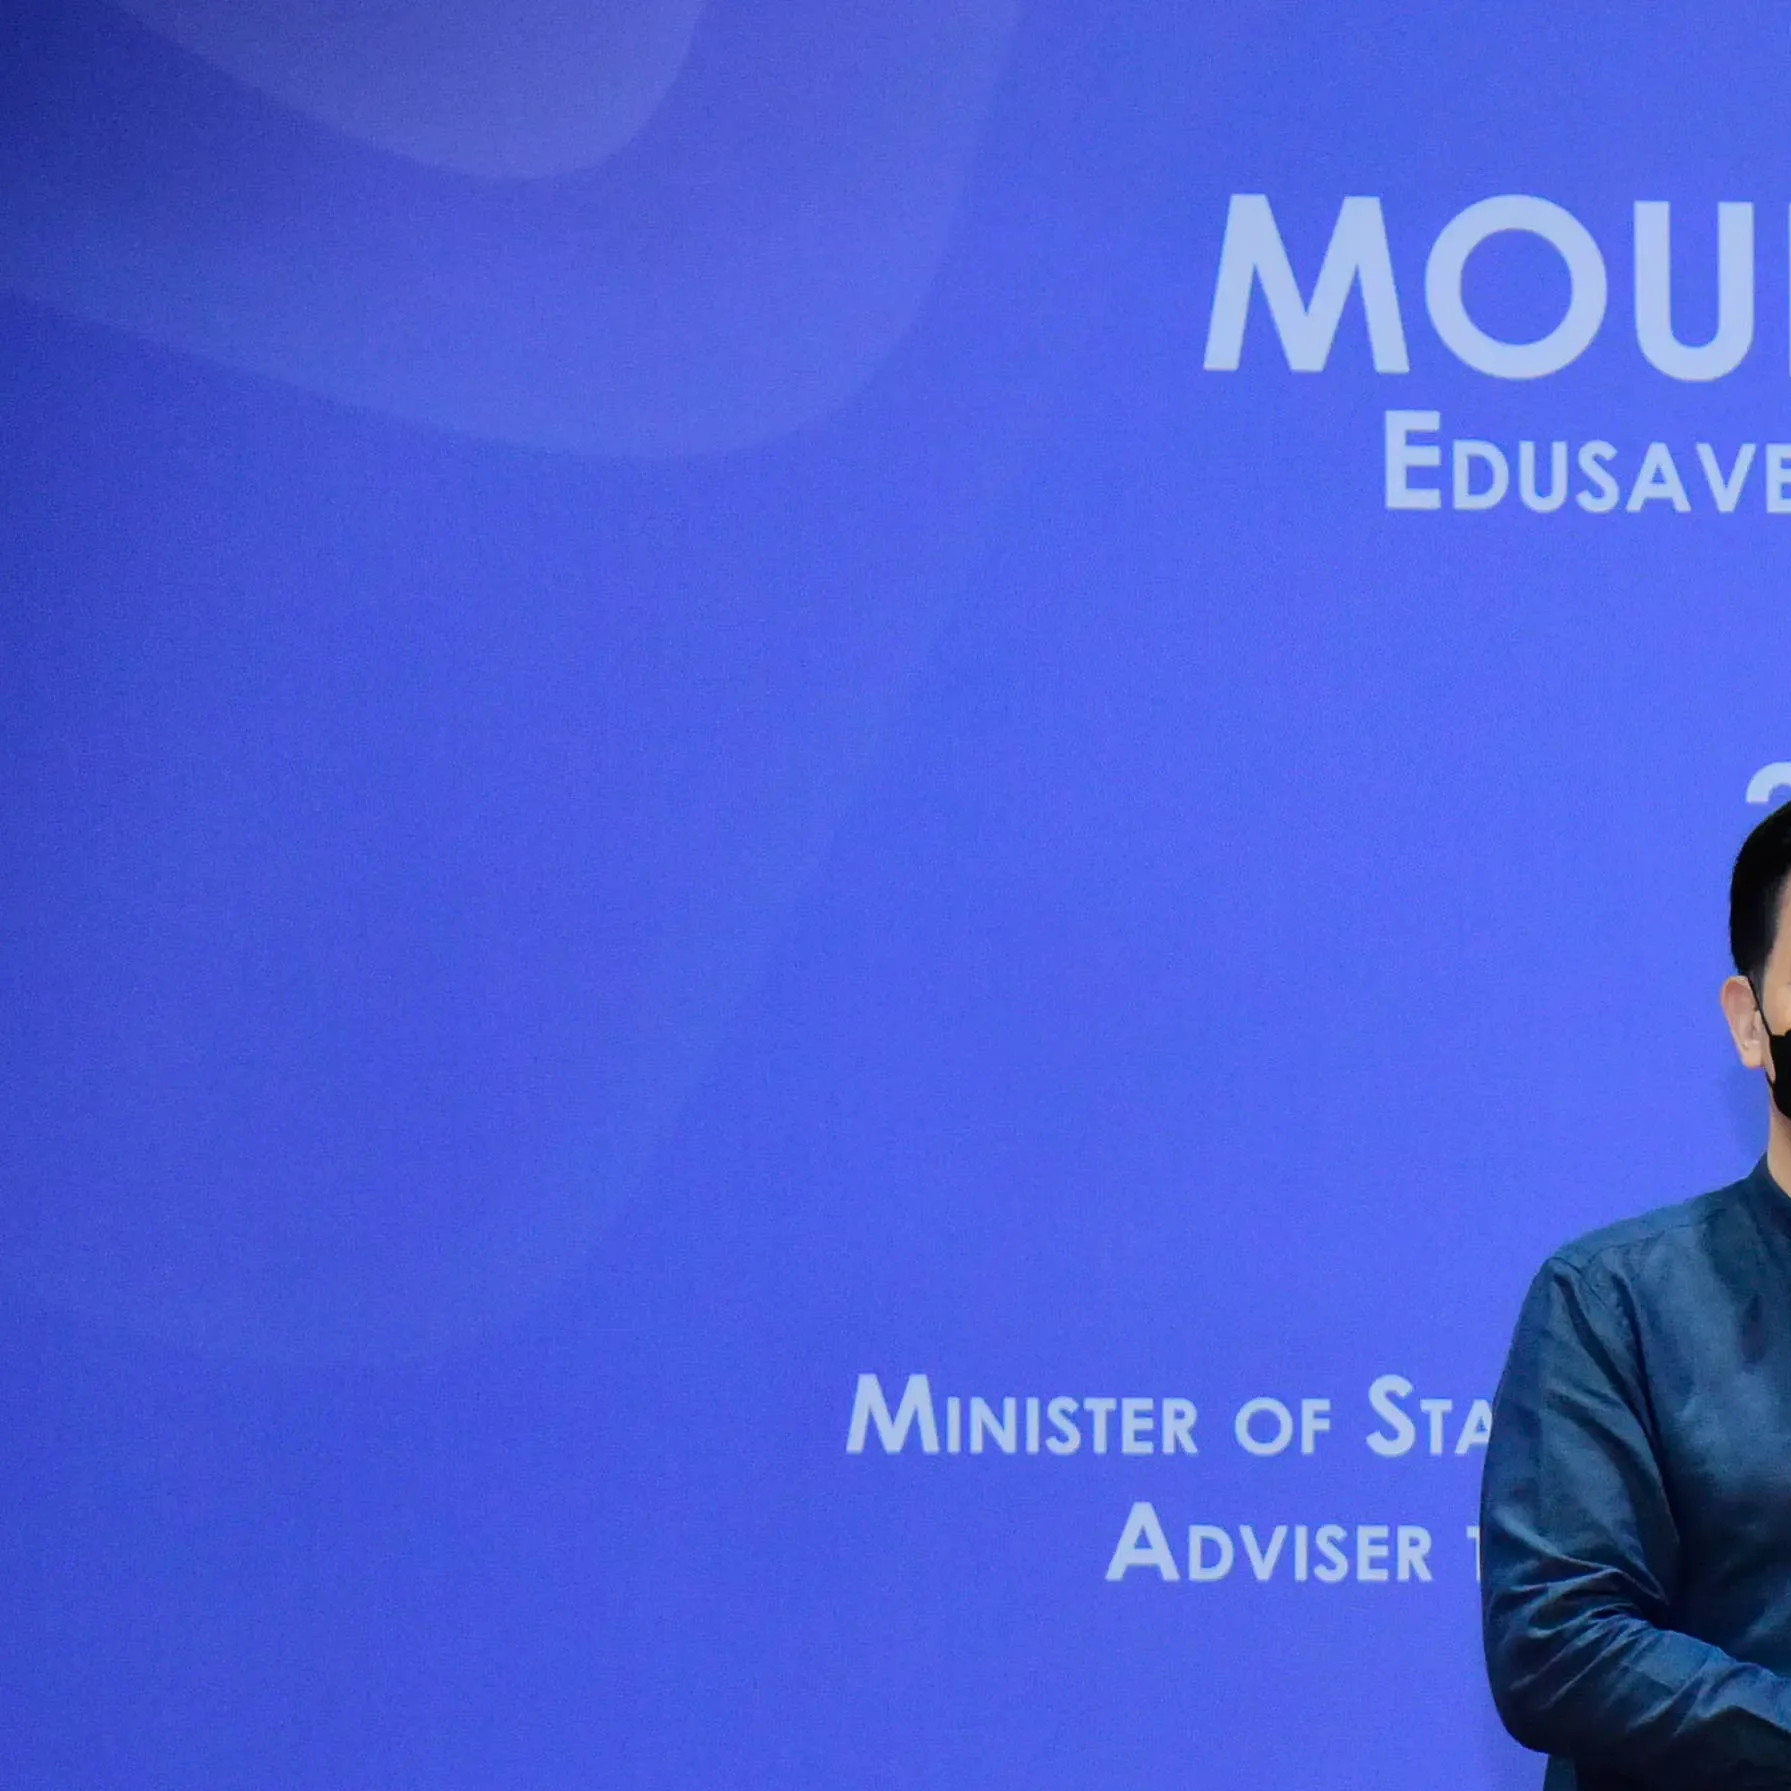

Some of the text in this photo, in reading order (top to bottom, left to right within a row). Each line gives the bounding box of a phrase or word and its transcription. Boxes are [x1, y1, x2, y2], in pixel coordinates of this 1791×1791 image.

[846, 1373, 1198, 1455] MINISTER
[1234, 1398, 1331, 1456] OF
[1106, 1501, 1433, 1583] ADVISER
